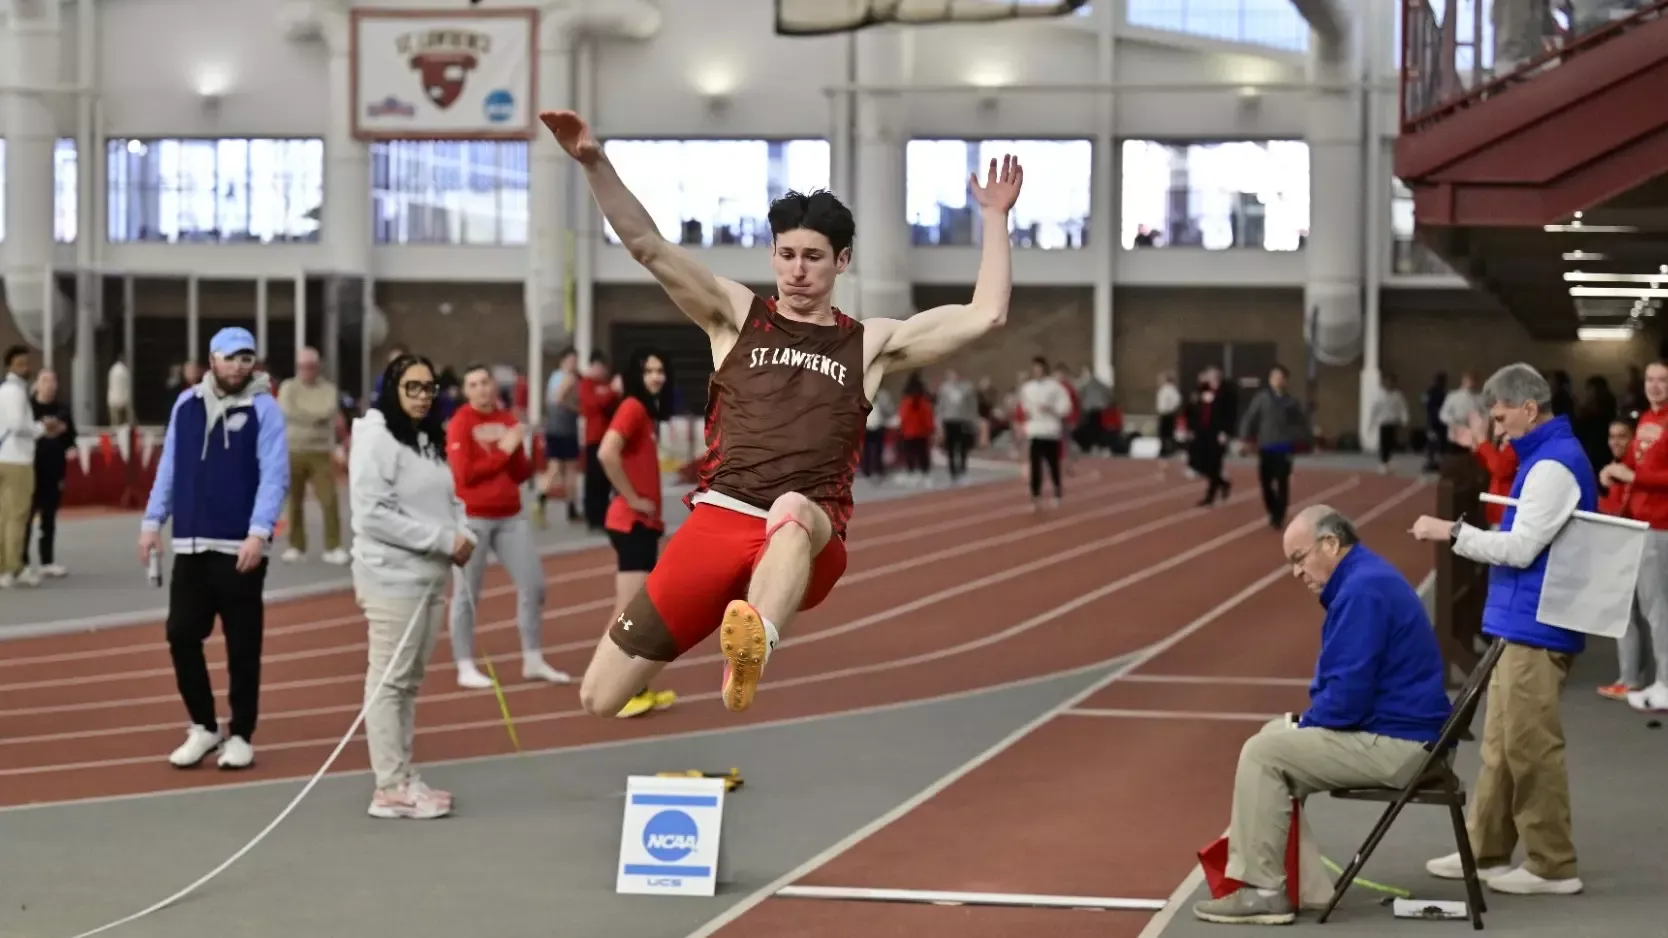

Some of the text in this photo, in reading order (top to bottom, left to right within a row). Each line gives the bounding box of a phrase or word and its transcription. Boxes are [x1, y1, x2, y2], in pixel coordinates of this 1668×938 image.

[749, 347, 848, 386] ST. LAWRENCE
[647, 833, 697, 851] NCAA
[647, 878, 682, 887] UCS
